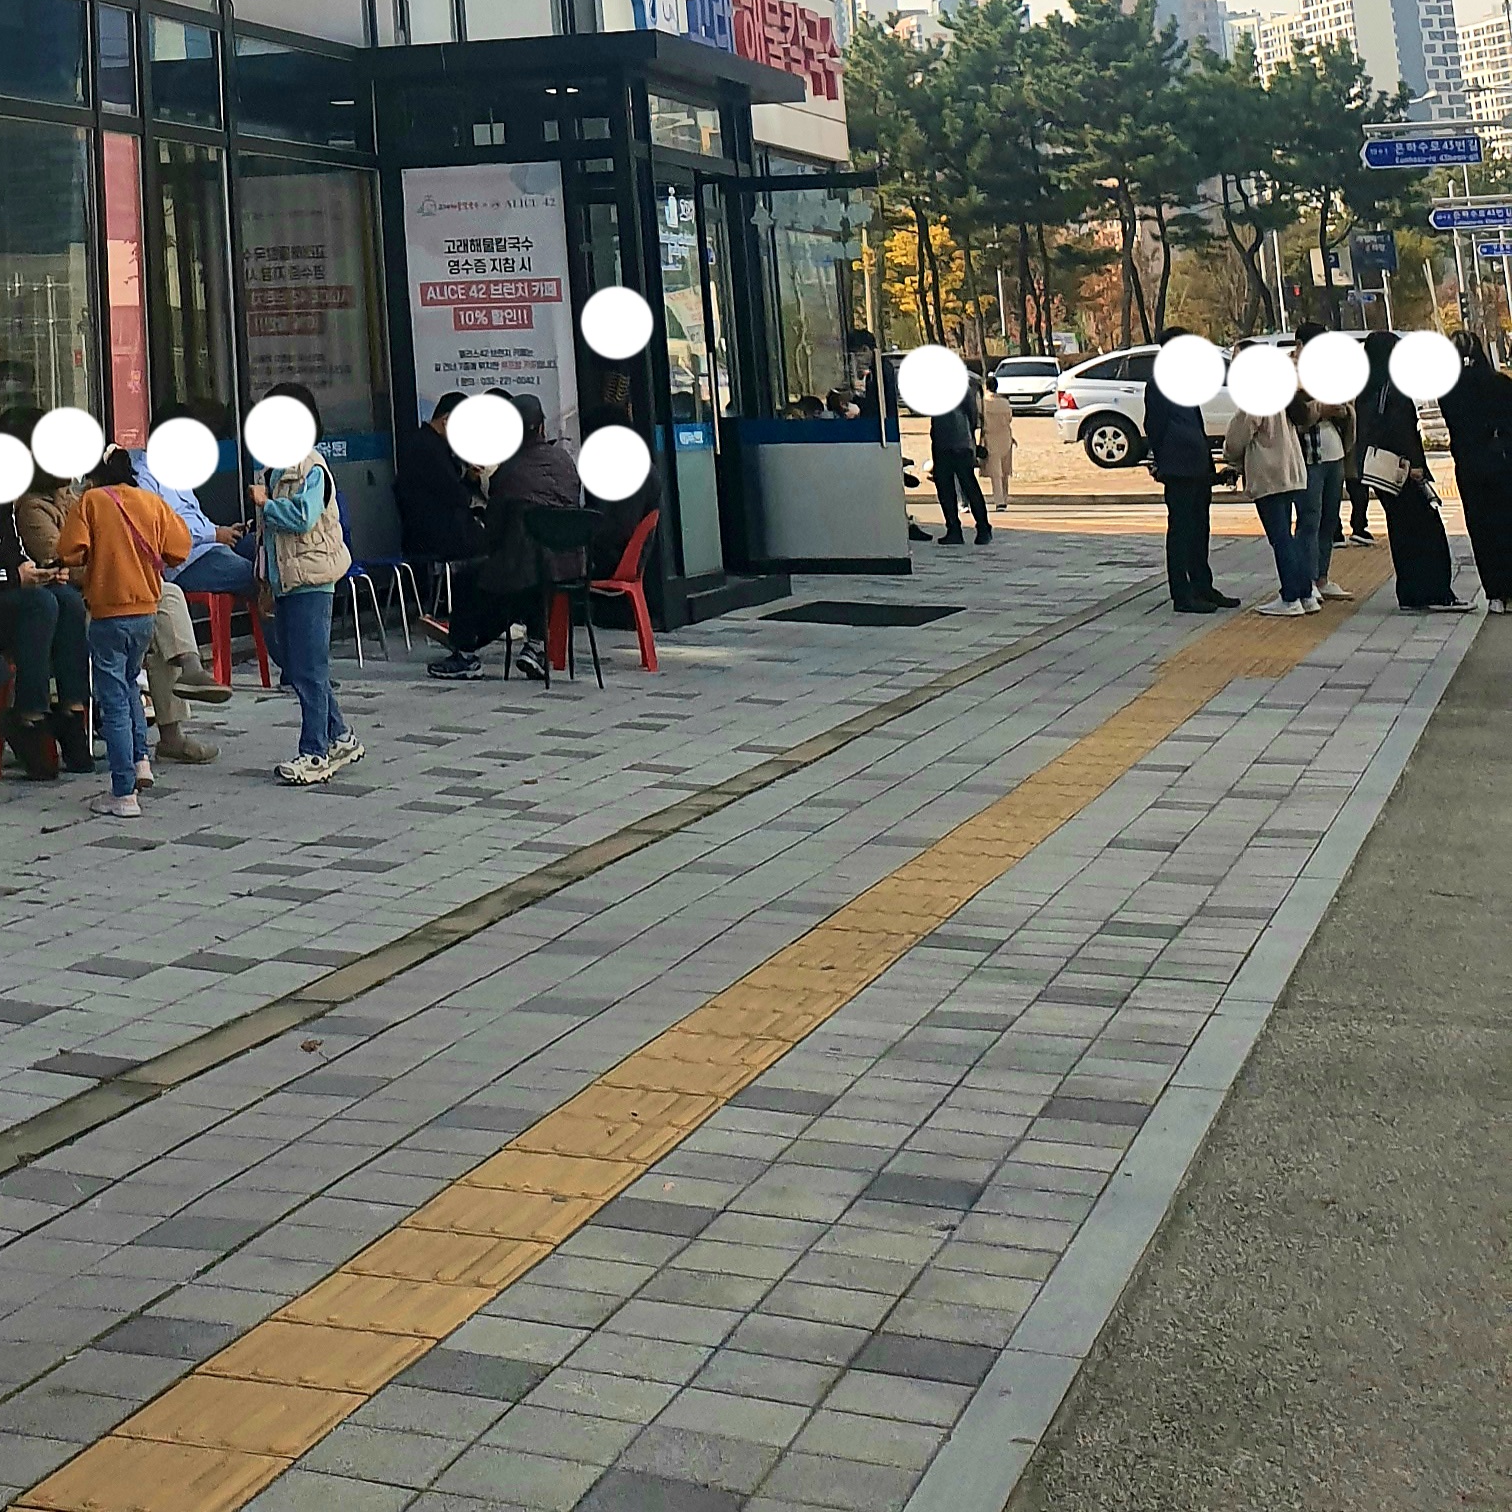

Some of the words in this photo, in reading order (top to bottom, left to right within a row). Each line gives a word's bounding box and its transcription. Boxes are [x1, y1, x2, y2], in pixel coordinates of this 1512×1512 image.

[444, 236, 533, 254] 고래해물칼국수
[448, 258, 487, 275] 영수증
[490, 257, 516, 273] 지참
[519, 256, 532, 272] 시
[426, 285, 467, 300] ALICE
[469, 284, 486, 298] 42
[490, 282, 529, 299] 브런치
[532, 281, 557, 297] 카페
[459, 311, 488, 325] 10%
